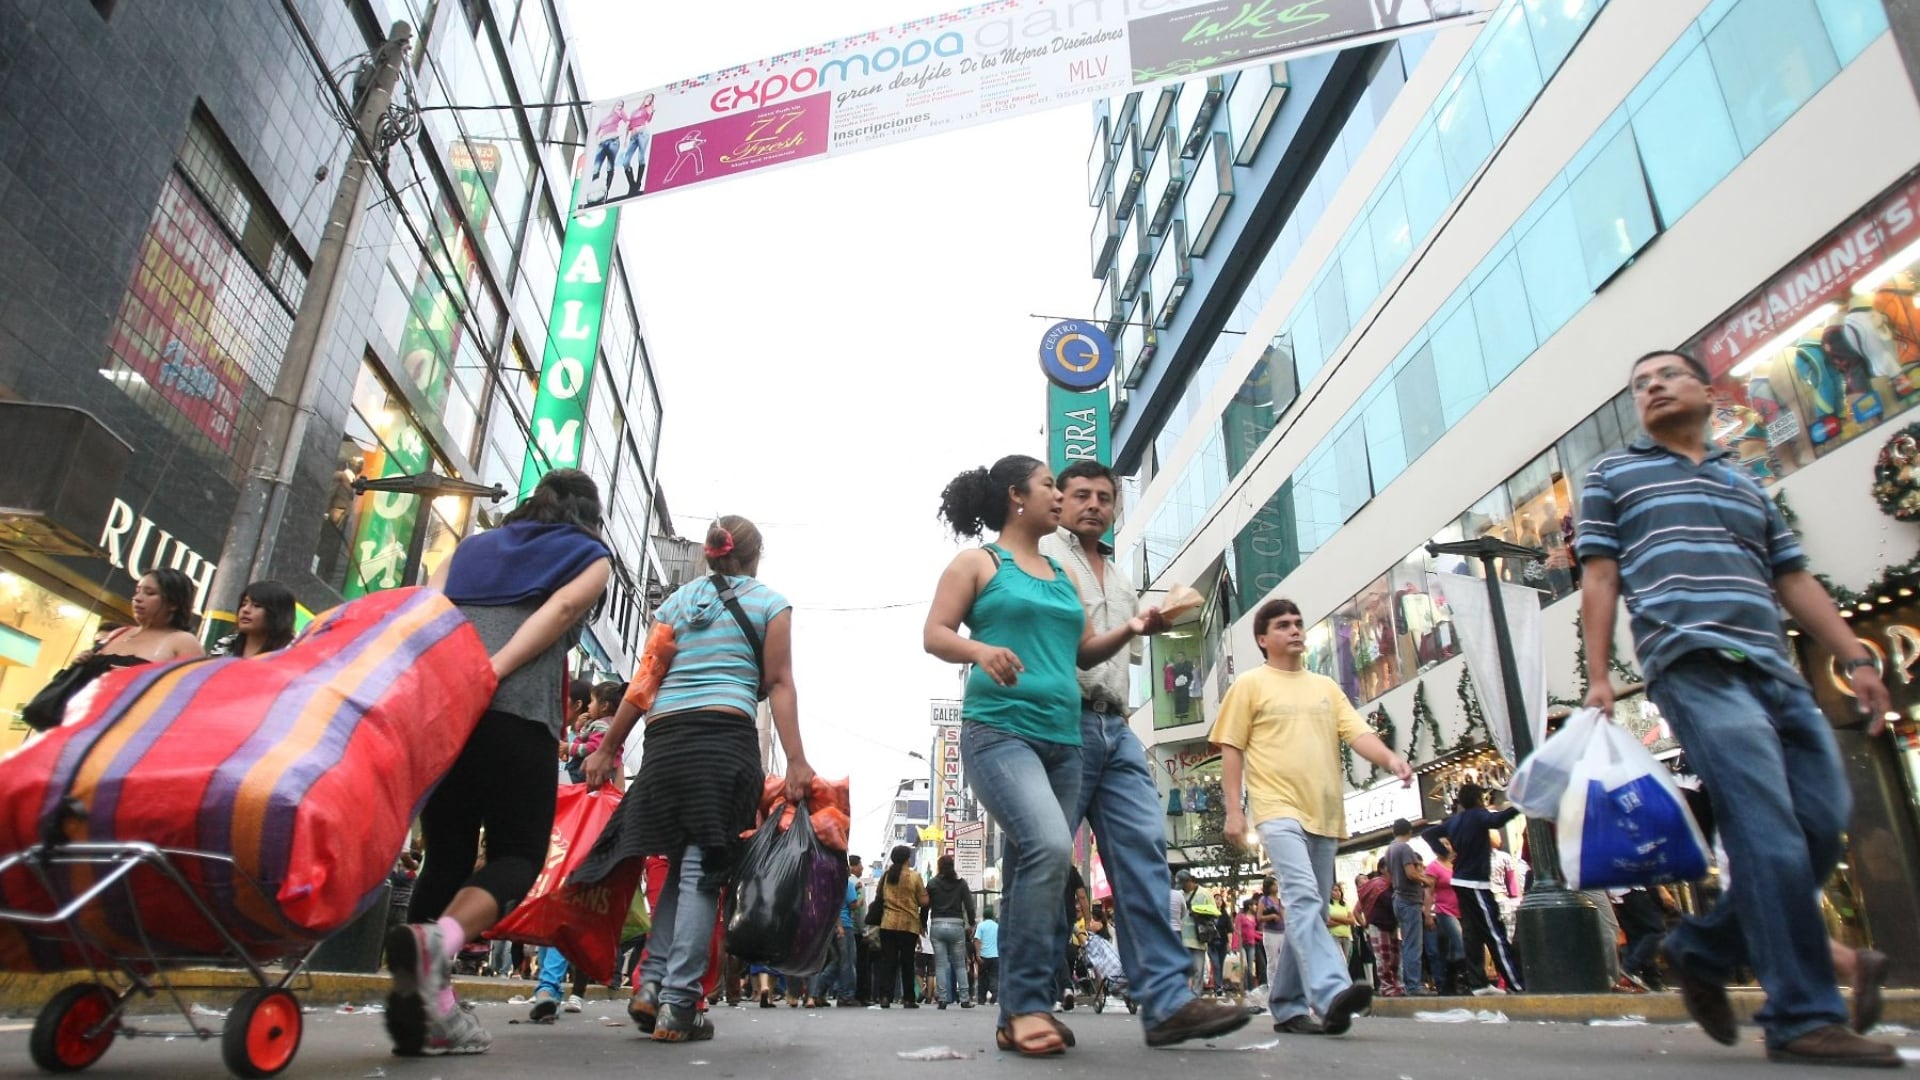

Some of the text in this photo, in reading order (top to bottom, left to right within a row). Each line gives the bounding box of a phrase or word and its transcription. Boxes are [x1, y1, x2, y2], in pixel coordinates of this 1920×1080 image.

[837, 83, 883, 108] gran
[888, 61, 952, 90] desfile
[959, 57, 978, 75] De
[980, 54, 997, 69] los
[1000, 45, 1049, 65] Mejores
[1051, 28, 1124, 54] Diseñadores
[1069, 55, 1109, 83] MLV
[833, 112, 931, 142] Inscripciones
[1045, 323, 1079, 351] CENTRO
[946, 730, 958, 807] SANTA
